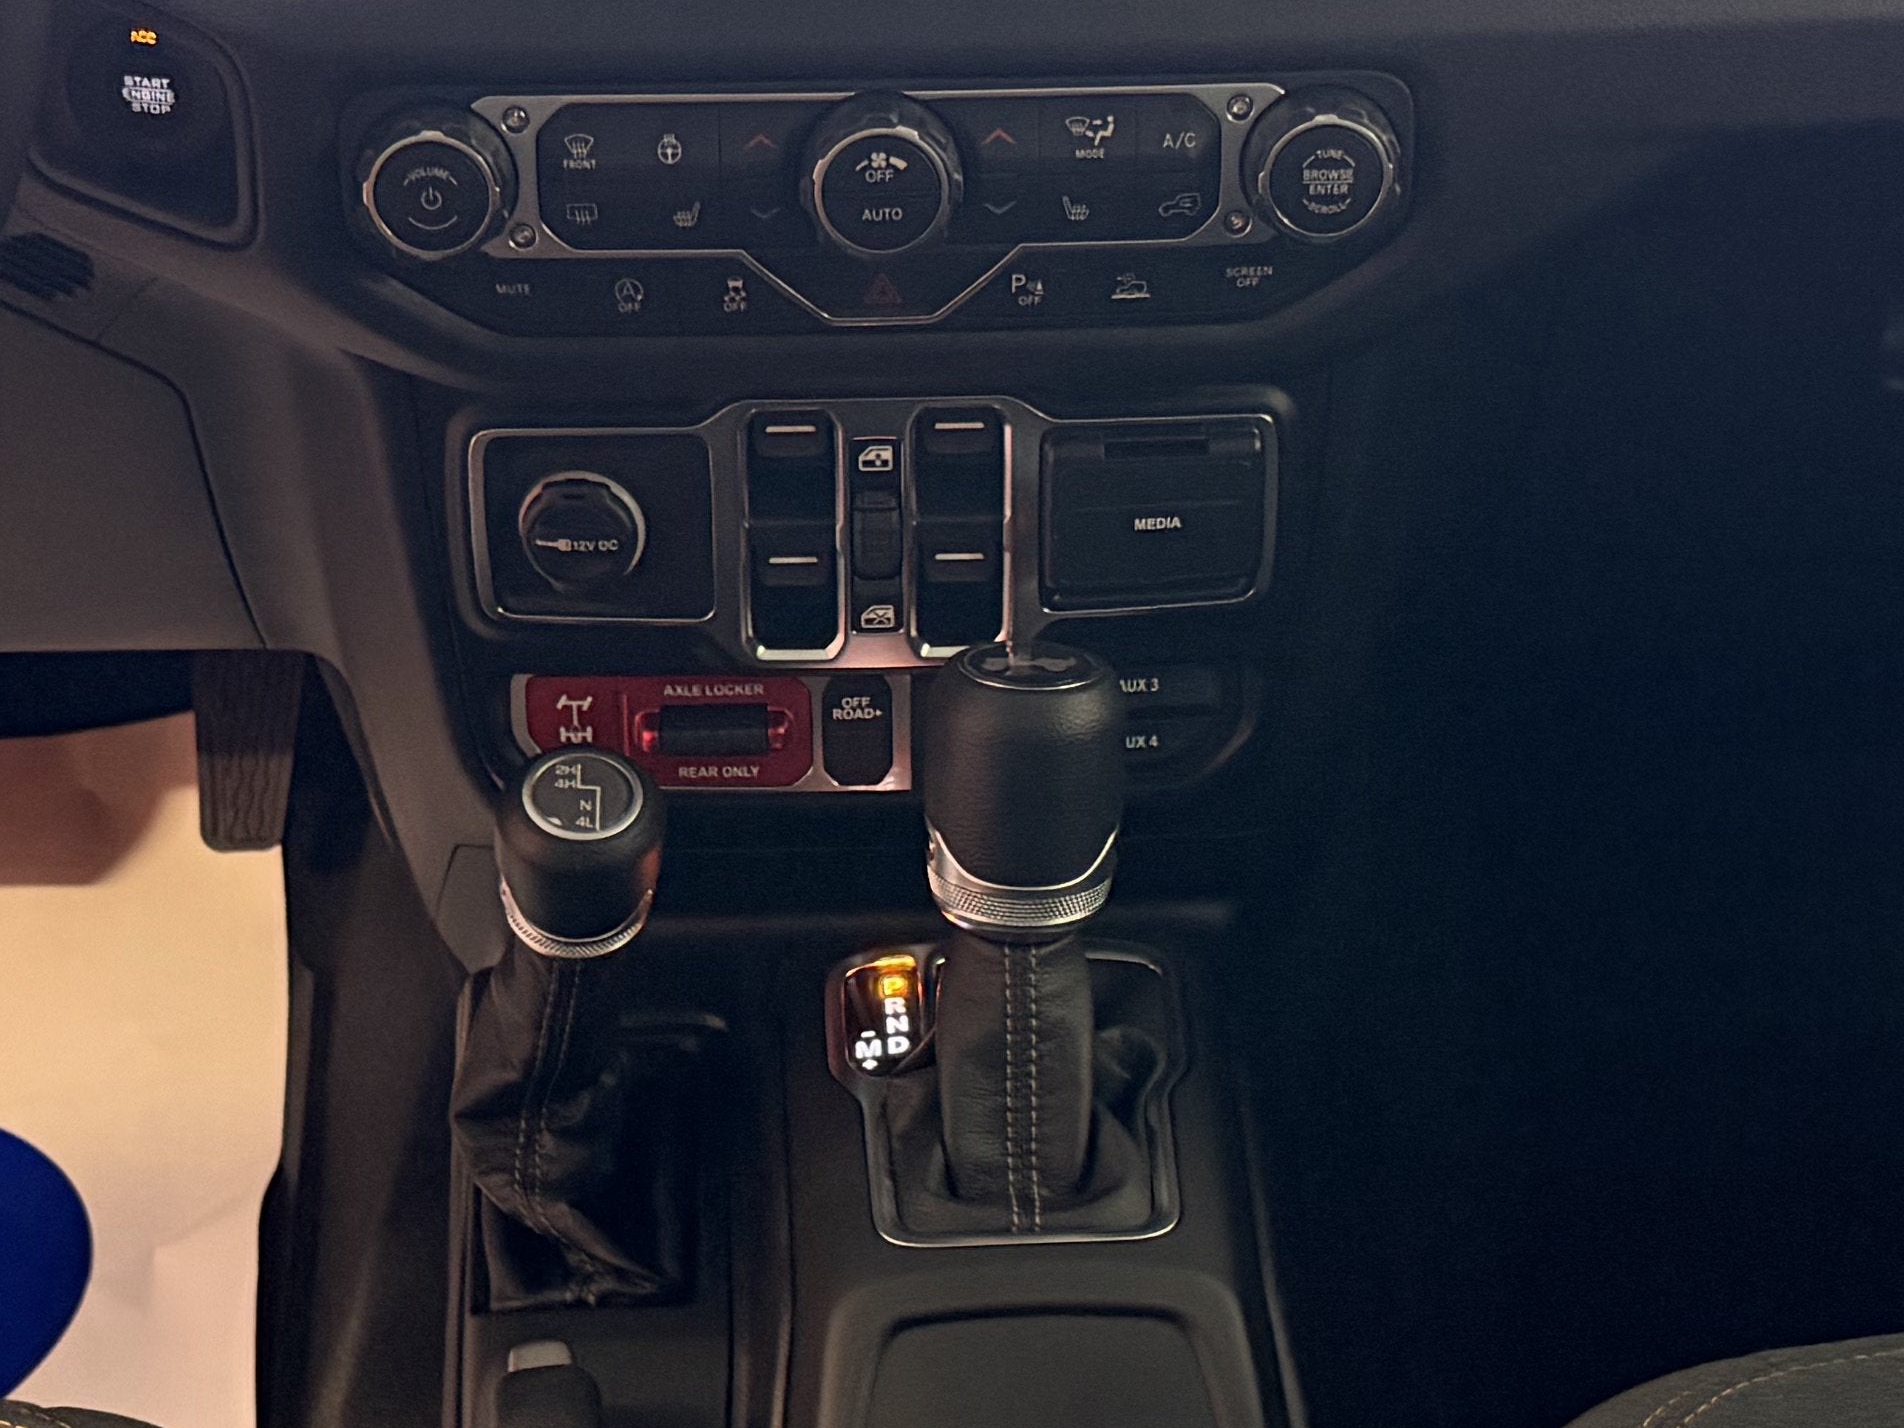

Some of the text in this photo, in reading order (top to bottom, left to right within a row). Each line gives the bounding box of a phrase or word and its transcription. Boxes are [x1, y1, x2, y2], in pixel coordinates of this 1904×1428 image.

[130, 29, 157, 45] ACC
[123, 75, 171, 89] START
[131, 102, 171, 114] STOP
[1162, 132, 1196, 149] A/C
[1075, 148, 1105, 159] MODE
[1316, 148, 1344, 161] TUNE
[562, 158, 596, 170] FRONT
[865, 169, 894, 183] OFF
[1302, 168, 1354, 181] BROWSE
[1308, 183, 1349, 195] ENTER
[862, 207, 903, 221] AUTO
[1225, 266, 1274, 278] SCREEN
[1236, 277, 1259, 288] OFF
[495, 283, 531, 296] MUTE
[723, 300, 747, 313] OFF
[1018, 295, 1042, 307] OFF
[618, 302, 642, 314] OFF
[1133, 516, 1182, 531] MEDIA
[571, 539, 596, 552] 12V
[663, 682, 765, 697] AXLE LOCKER
[1150, 677, 1160, 691] 3
[841, 696, 872, 709] OFF
[1148, 735, 1158, 747] 4
[555, 764, 577, 775] 2H
[678, 765, 760, 780] REAR ONLY
[554, 778, 577, 789] 4H
[579, 799, 593, 812] N
[575, 816, 594, 829] 4L
[883, 976, 905, 996] P
[884, 997, 907, 1015] R
[886, 1015, 909, 1034] N
[855, 1039, 882, 1059] M
[887, 1036, 911, 1055] D
